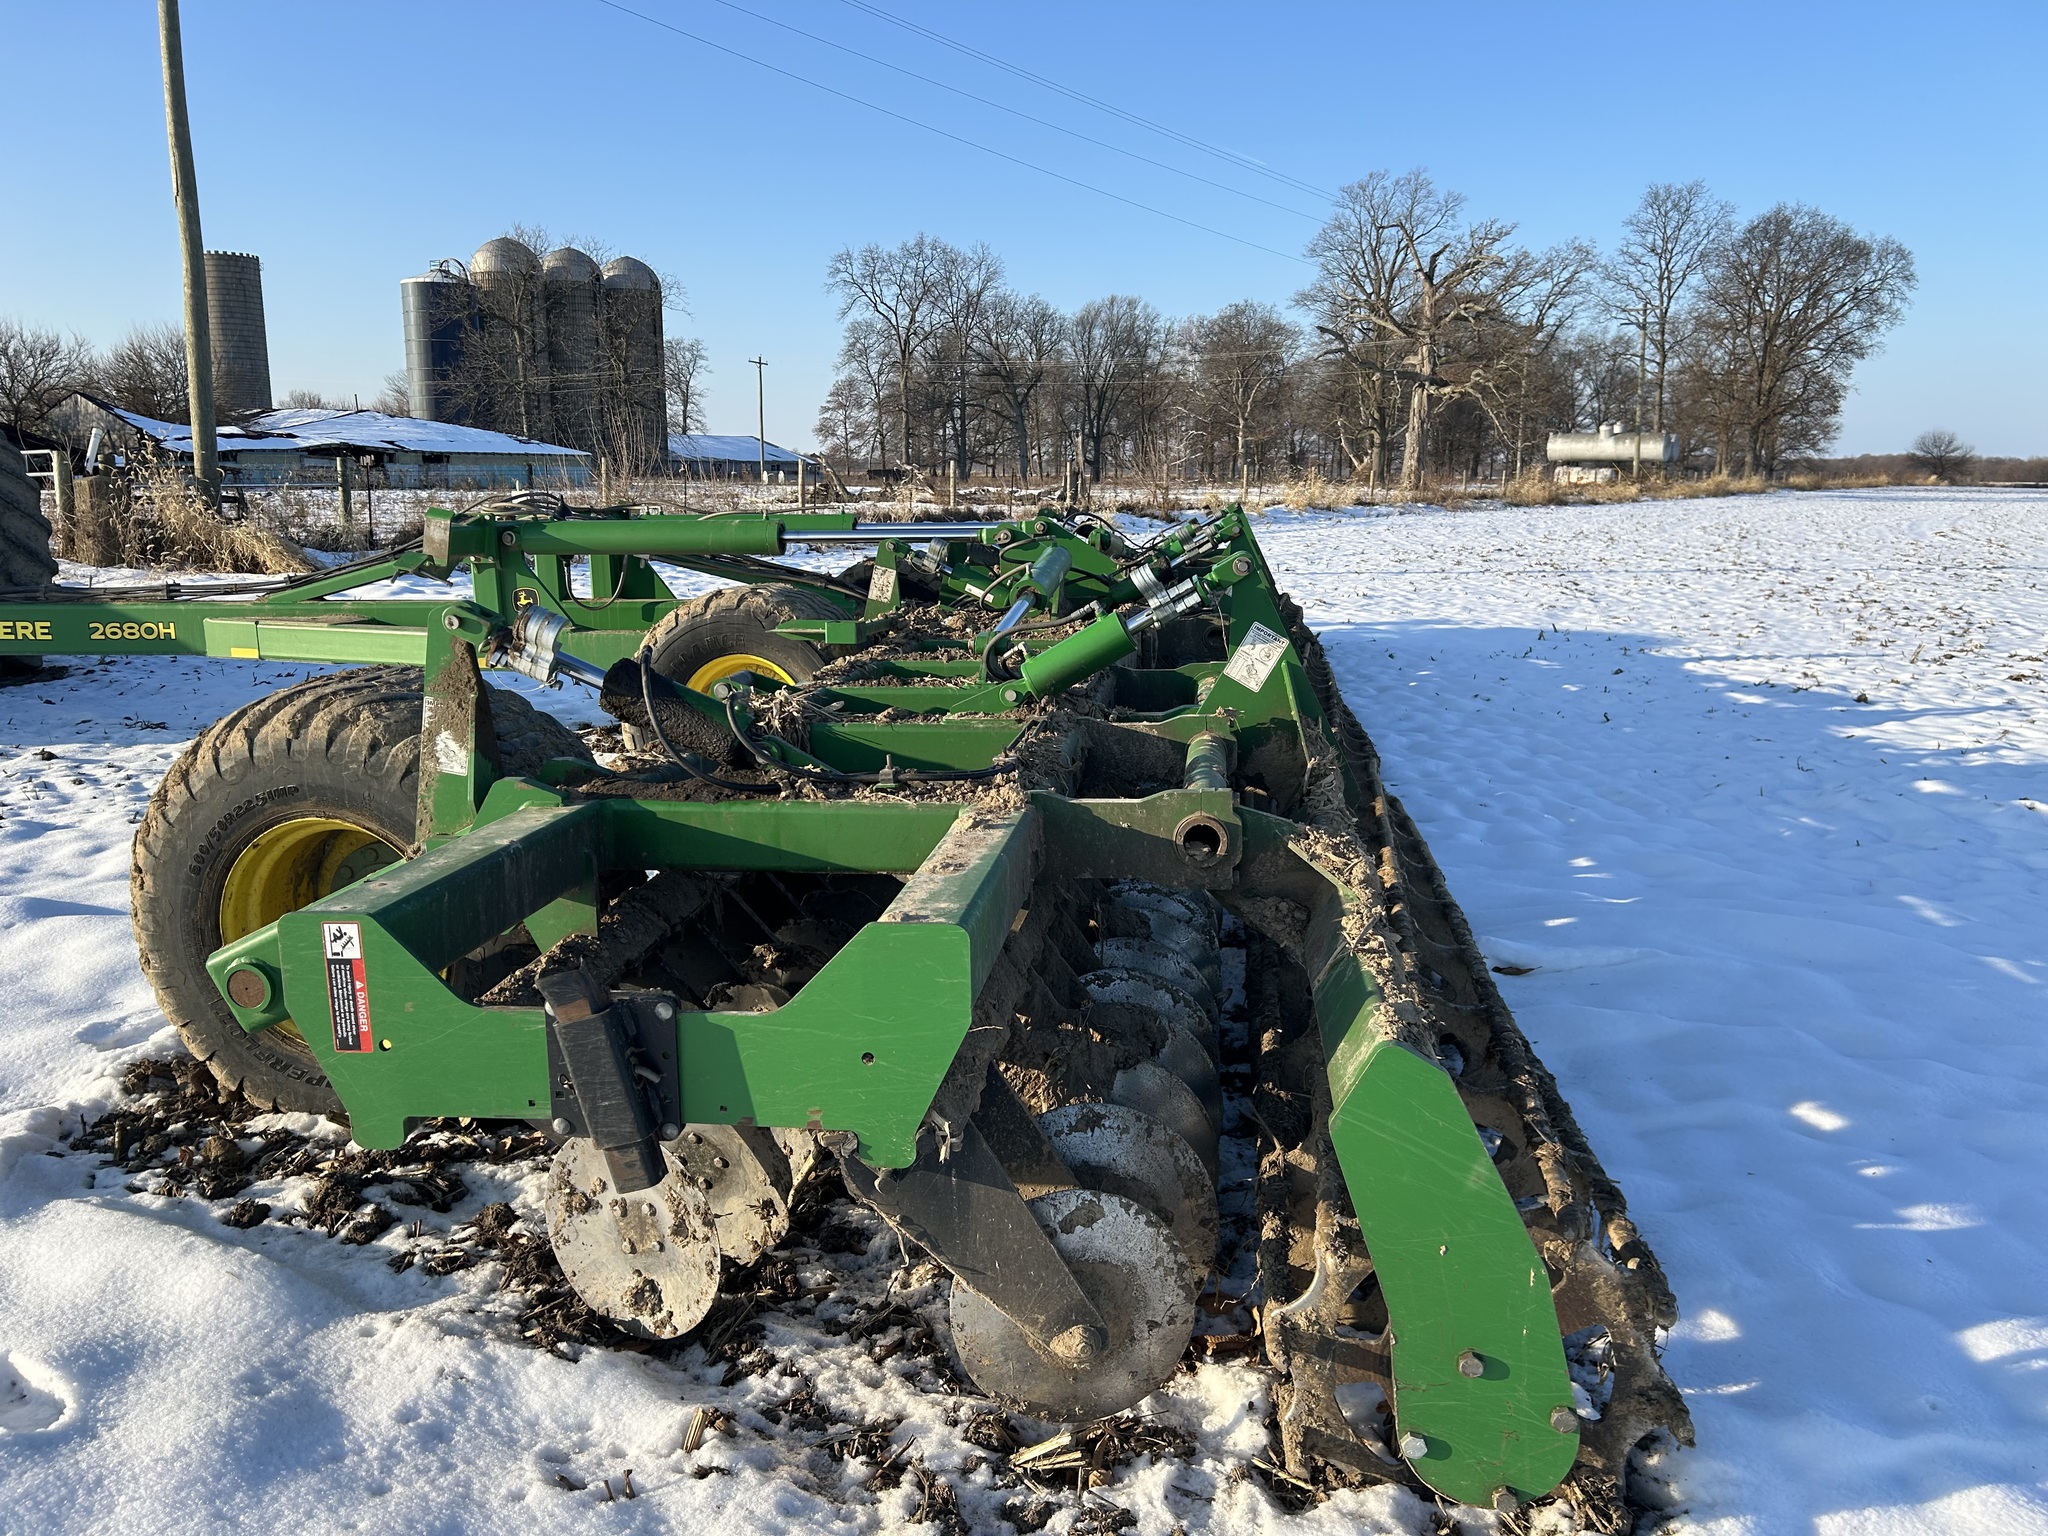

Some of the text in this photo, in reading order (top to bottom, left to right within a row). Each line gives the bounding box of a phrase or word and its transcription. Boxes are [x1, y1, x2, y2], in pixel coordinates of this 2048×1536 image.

[0, 620, 176, 641] ERE 2680H
[1253, 625, 1286, 645] IMPORTANT
[356, 992, 368, 1032] DANGER
